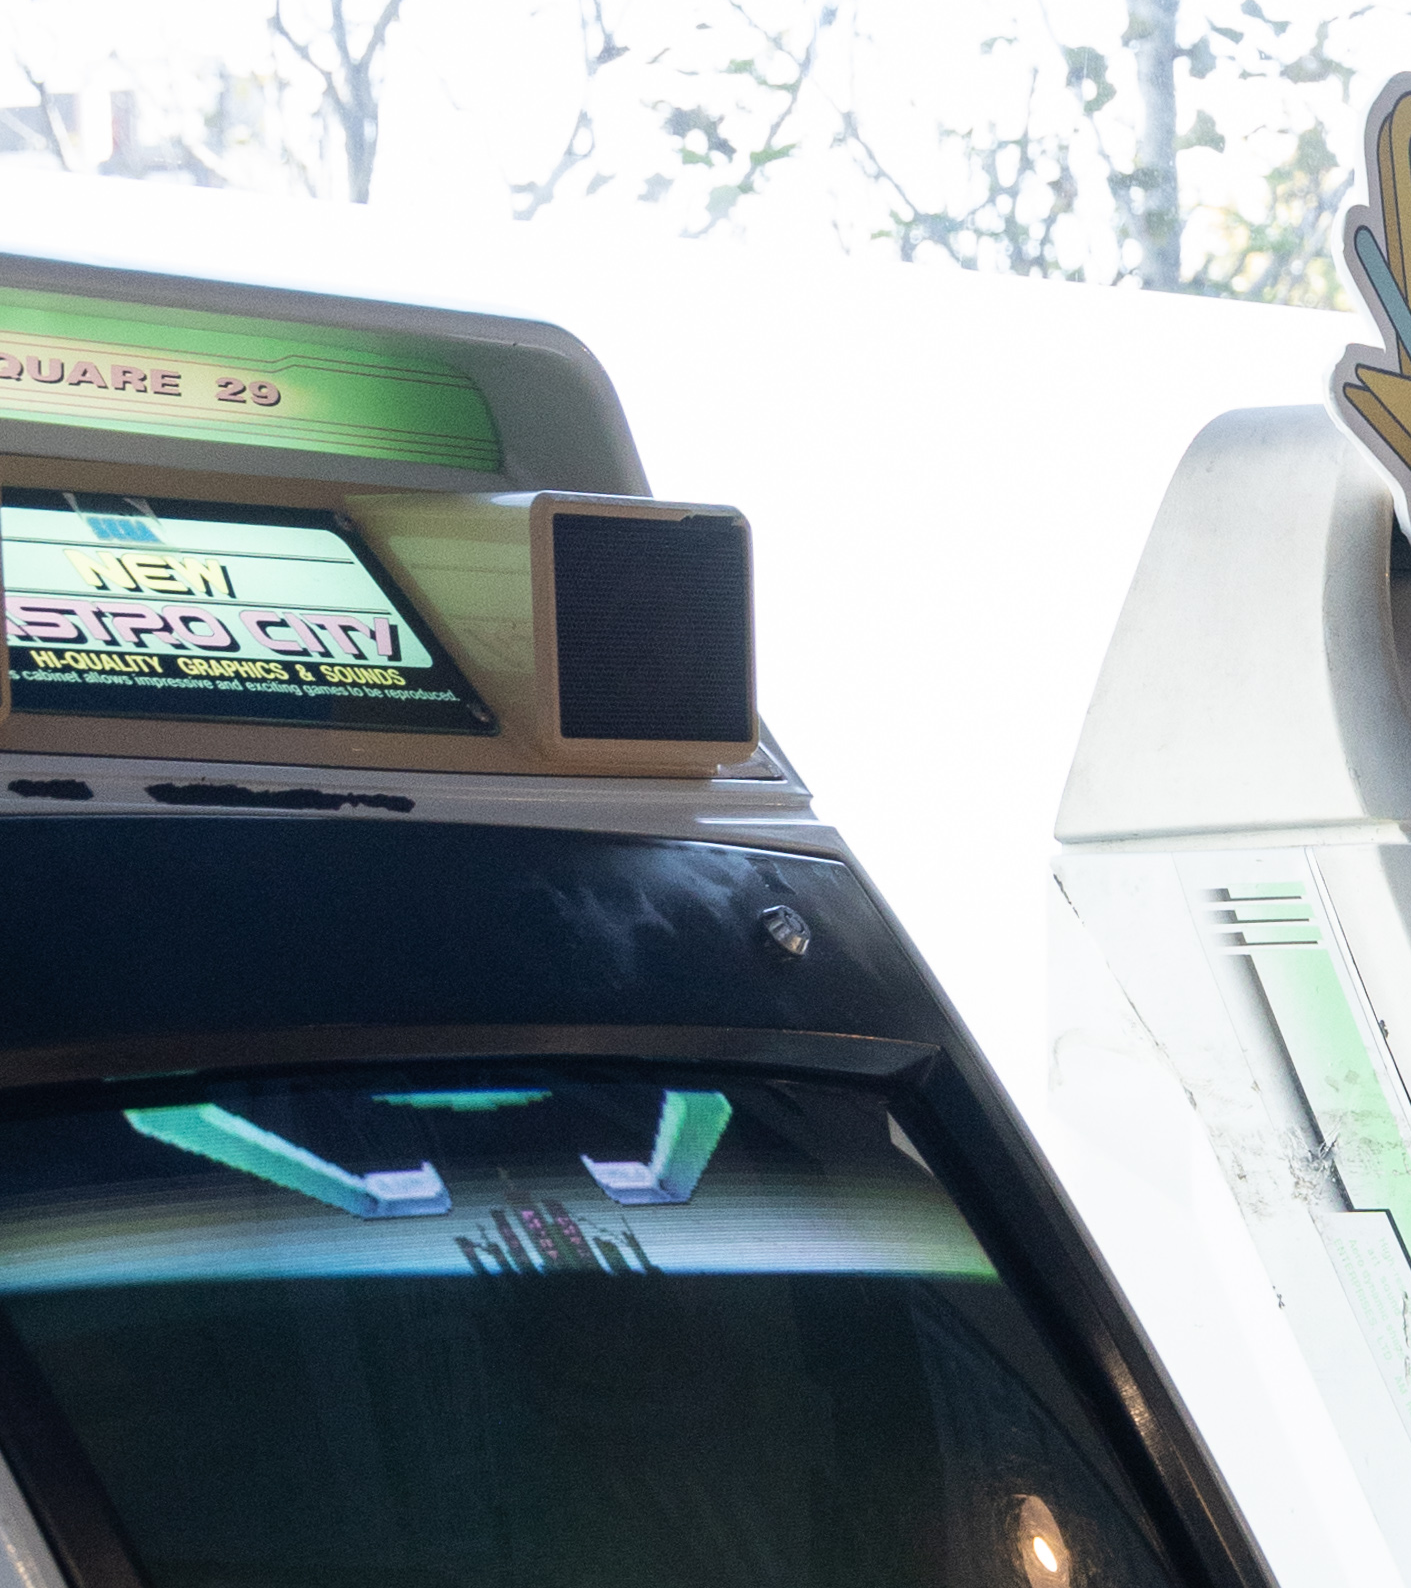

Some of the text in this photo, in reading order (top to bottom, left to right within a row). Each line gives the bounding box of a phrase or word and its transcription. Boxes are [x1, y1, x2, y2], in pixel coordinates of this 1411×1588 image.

[214, 376, 282, 407] 29
[63, 548, 237, 599] NEW
[5, 595, 403, 662] STRO CITY
[23, 669, 82, 684] cabinet
[83, 671, 133, 686] allows
[134, 673, 214, 690] impressive
[217, 678, 244, 691] and
[245, 679, 303, 696] exciting
[302, 683, 348, 698] games
[348, 683, 364, 697] to
[365, 685, 382, 698] be
[384, 688, 461, 702] reproduced.
[30, 649, 407, 686] HI-QUALITY GRAPHICS & SOUNDS
